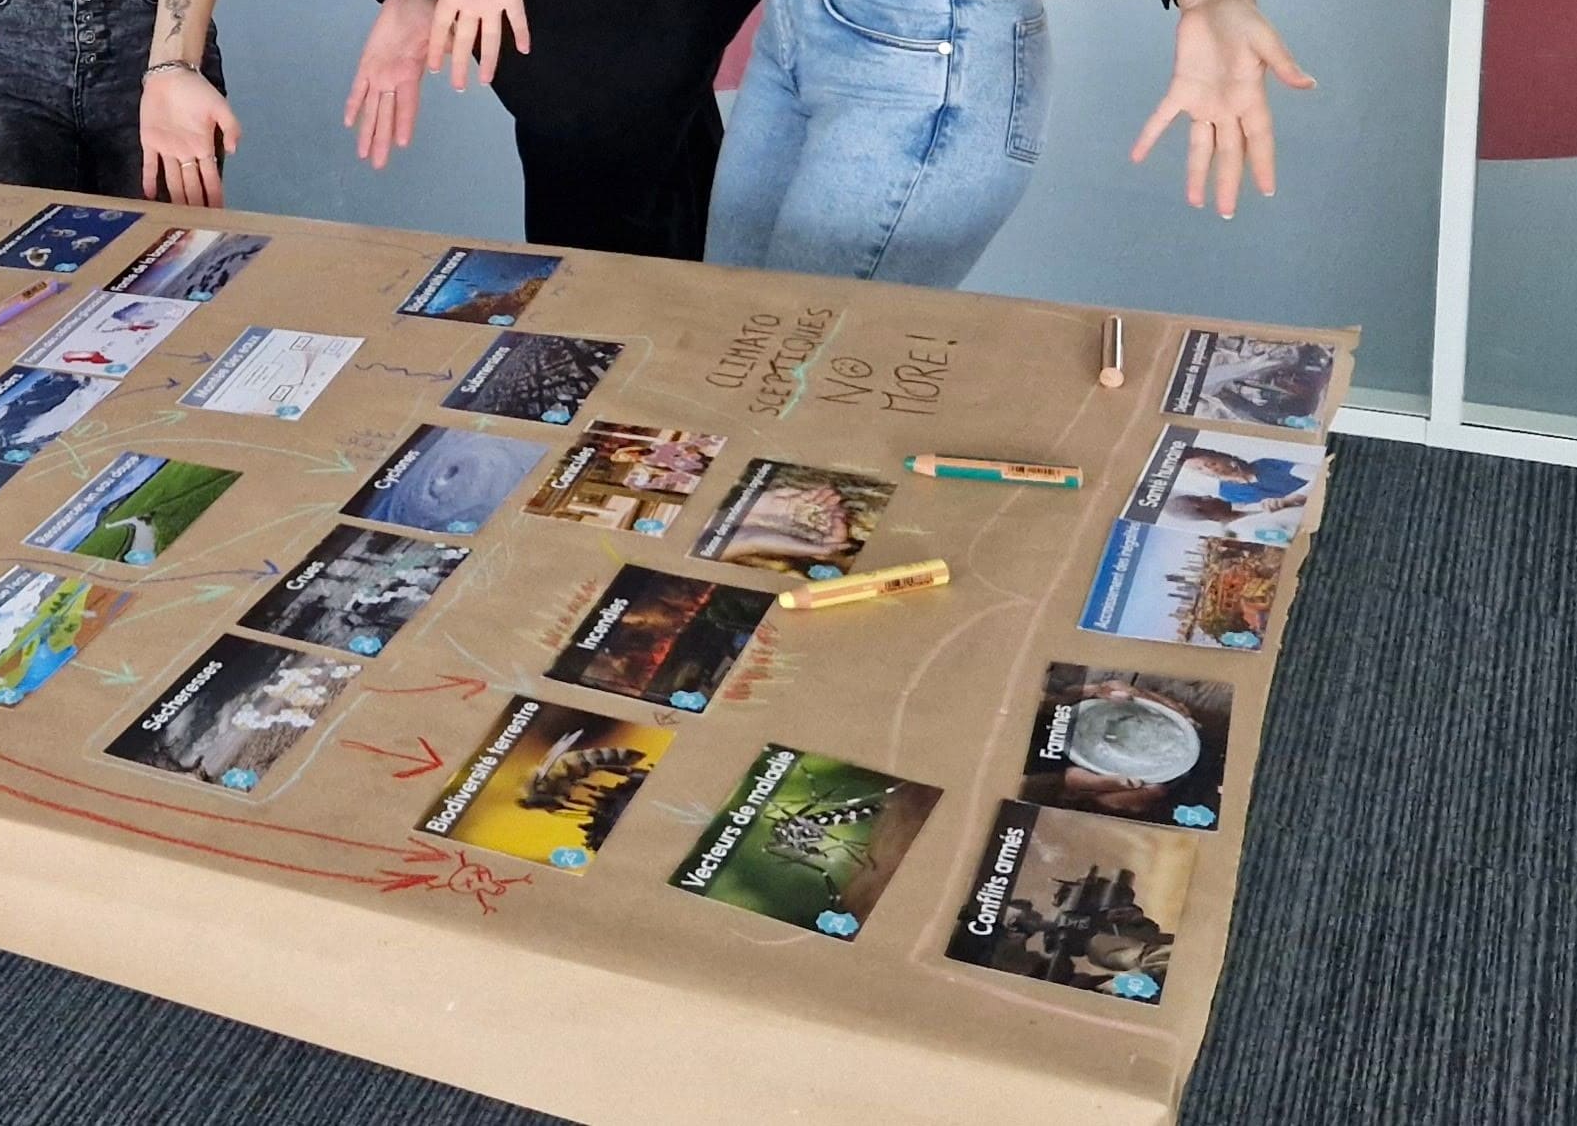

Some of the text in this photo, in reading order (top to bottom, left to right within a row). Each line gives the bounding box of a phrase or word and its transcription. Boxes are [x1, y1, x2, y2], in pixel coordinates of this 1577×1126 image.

[110, 274, 138, 291] Fonte
[132, 264, 148, 273] de
[147, 230, 190, 257] banquise
[440, 252, 466, 274] marine
[222, 354, 243, 368] des
[238, 335, 261, 353] eaux
[460, 345, 511, 393] Submersions
[705, 314, 780, 388] CLIMATO
[749, 308, 833, 415] SCEPTIQUES
[84, 493, 99, 502] en
[95, 477, 115, 492] eau
[110, 456, 139, 477] douce
[374, 450, 420, 489] Cyclones
[551, 446, 595, 490] Canicules
[1138, 441, 1186, 508] Santé humaine
[286, 560, 325, 592] Crues
[1112, 557, 1130, 572] des
[576, 595, 629, 652] Incendies
[141, 659, 223, 732] Sécheresses
[1039, 703, 1072, 759] Famines
[425, 700, 540, 834] Biodiversité terrestre
[680, 750, 796, 889] Vecteurs de maladie
[968, 827, 1025, 936] Conflits armés
